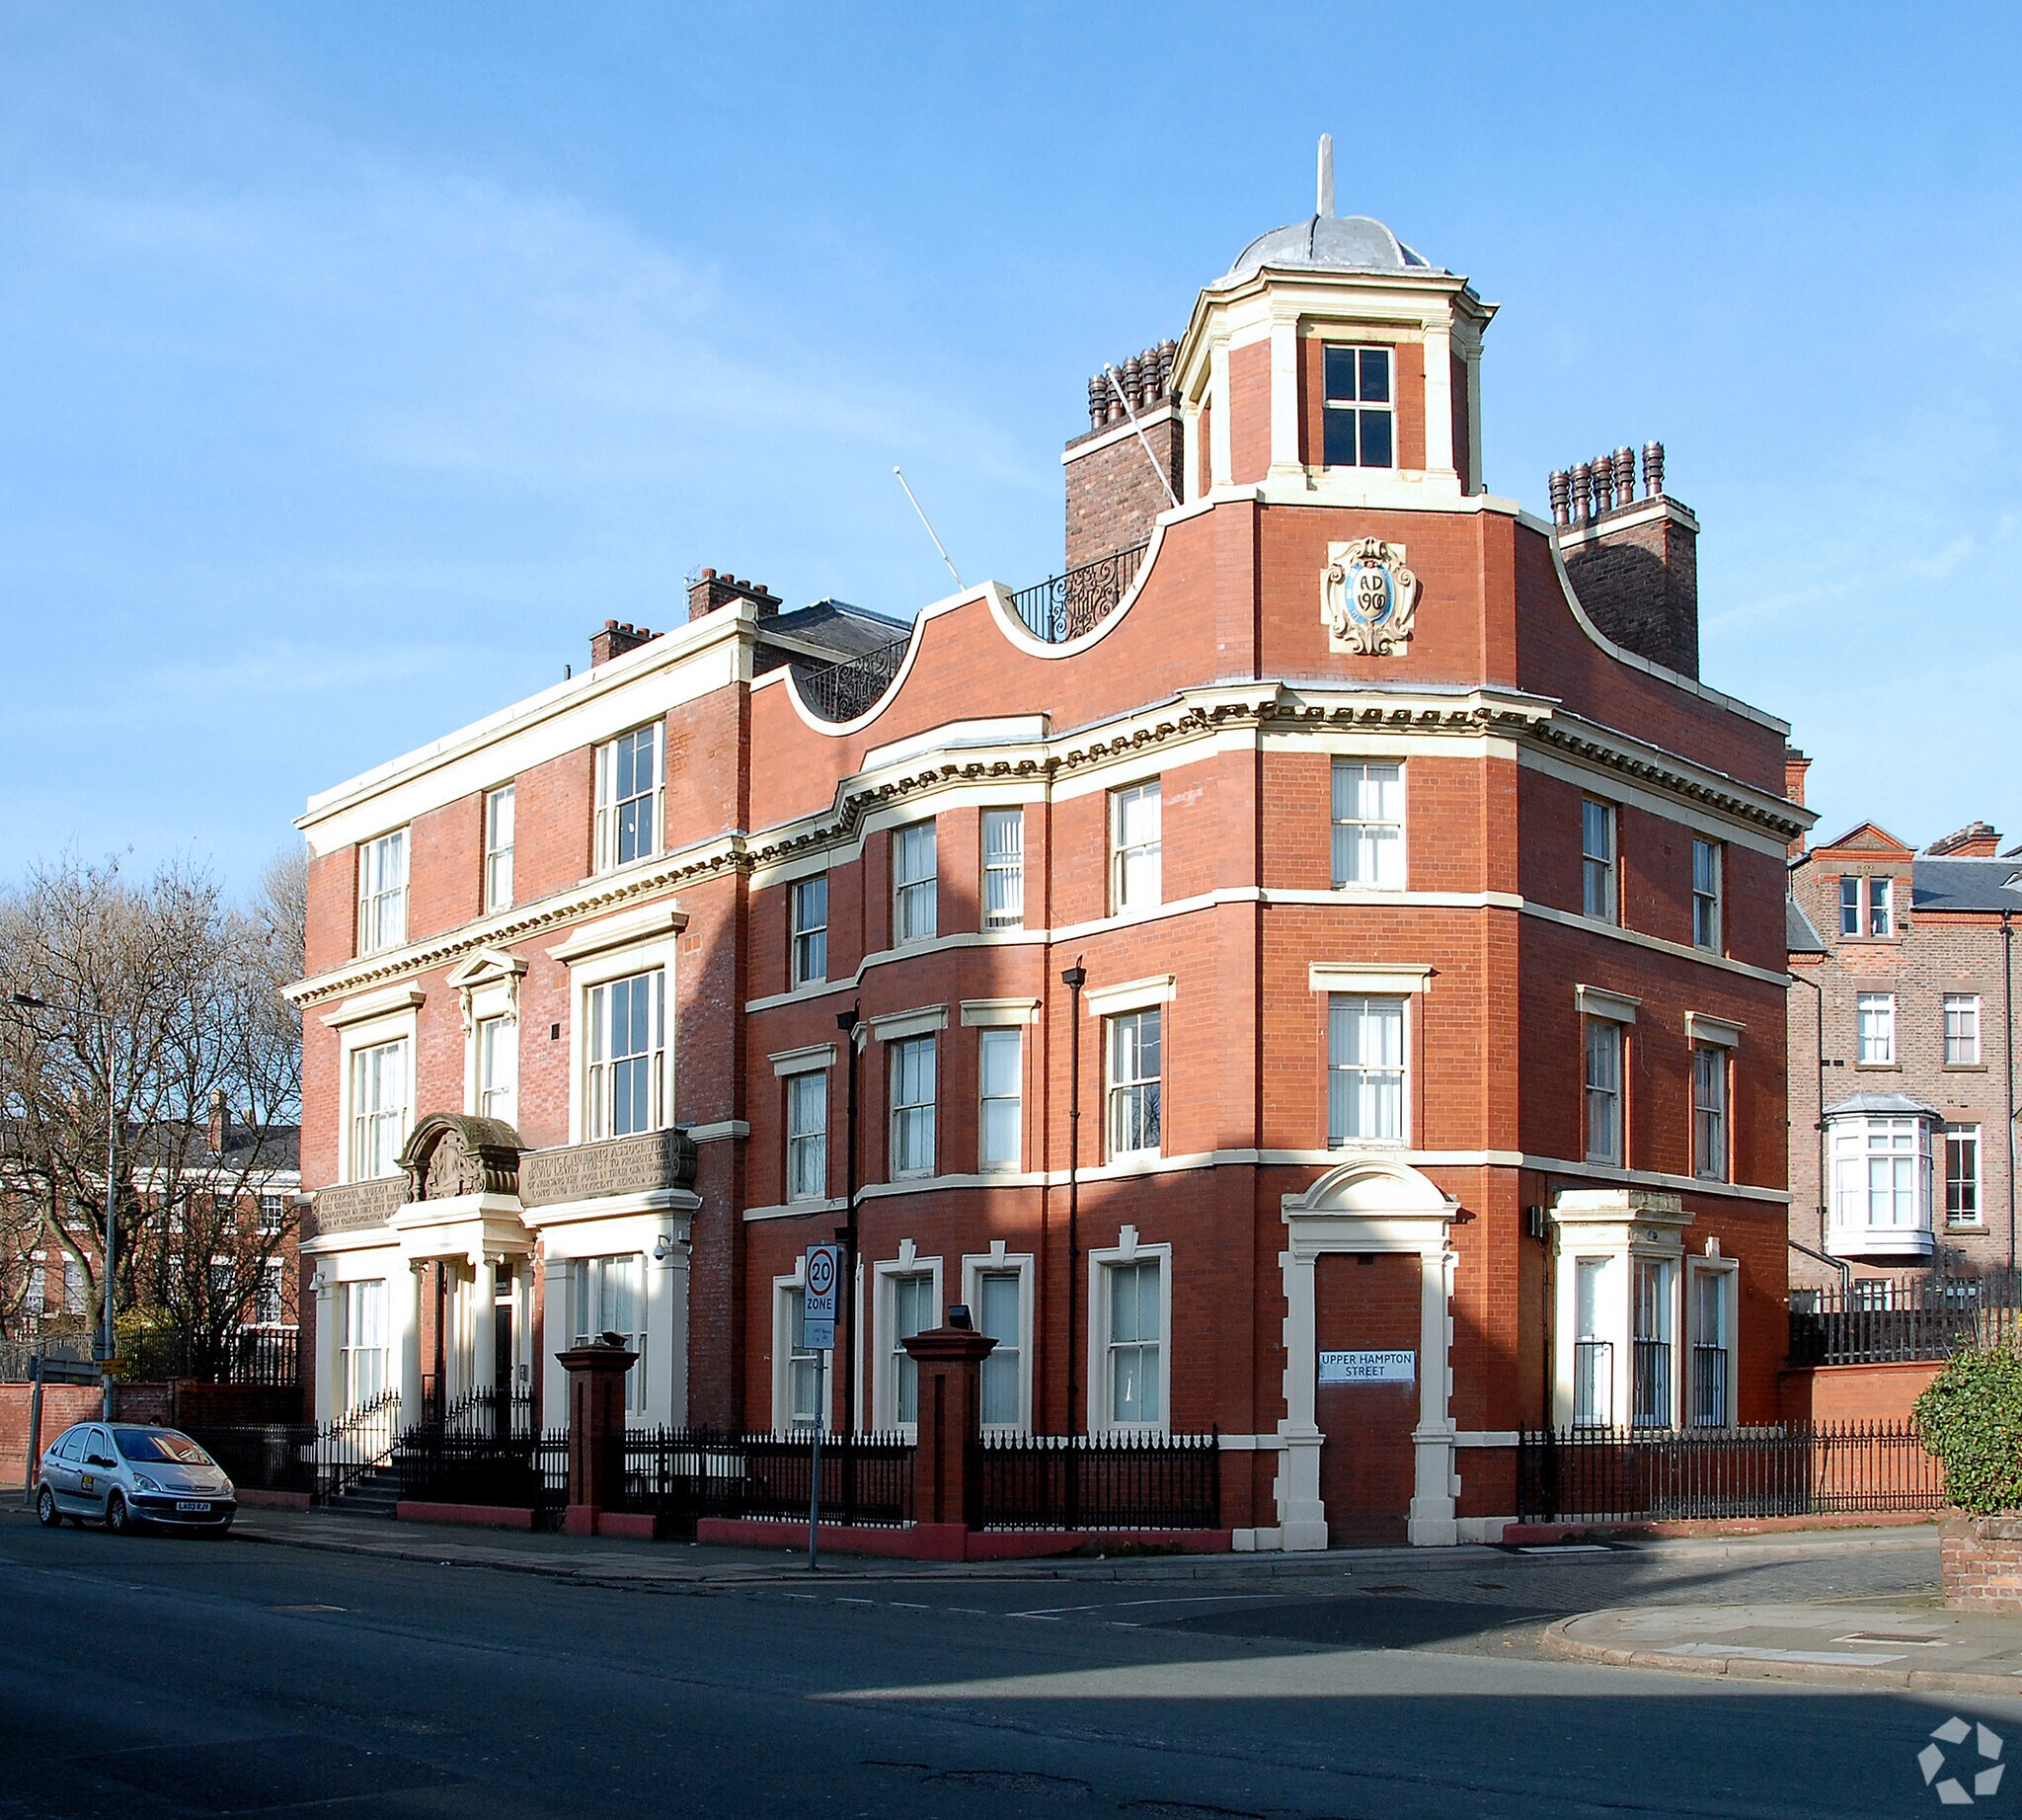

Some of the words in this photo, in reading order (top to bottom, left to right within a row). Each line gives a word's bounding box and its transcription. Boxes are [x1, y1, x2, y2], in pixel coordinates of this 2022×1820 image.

[1361, 576, 1382, 591] AD
[531, 1154, 568, 1170] DISTRICT
[572, 1148, 608, 1164] NURSING
[611, 1139, 670, 1157] ASSOCIATION
[529, 1168, 551, 1180] DAVID
[554, 1163, 579, 1176] LEWIS
[583, 1158, 608, 1172] TRUST
[610, 1158, 619, 1167] TO
[812, 1262, 830, 1281] 20
[807, 1298, 832, 1310] ZONE
[1322, 1355, 1357, 1365] UPPER
[1360, 1354, 1412, 1364] HAMPTON
[1346, 1366, 1385, 1377] STREET
